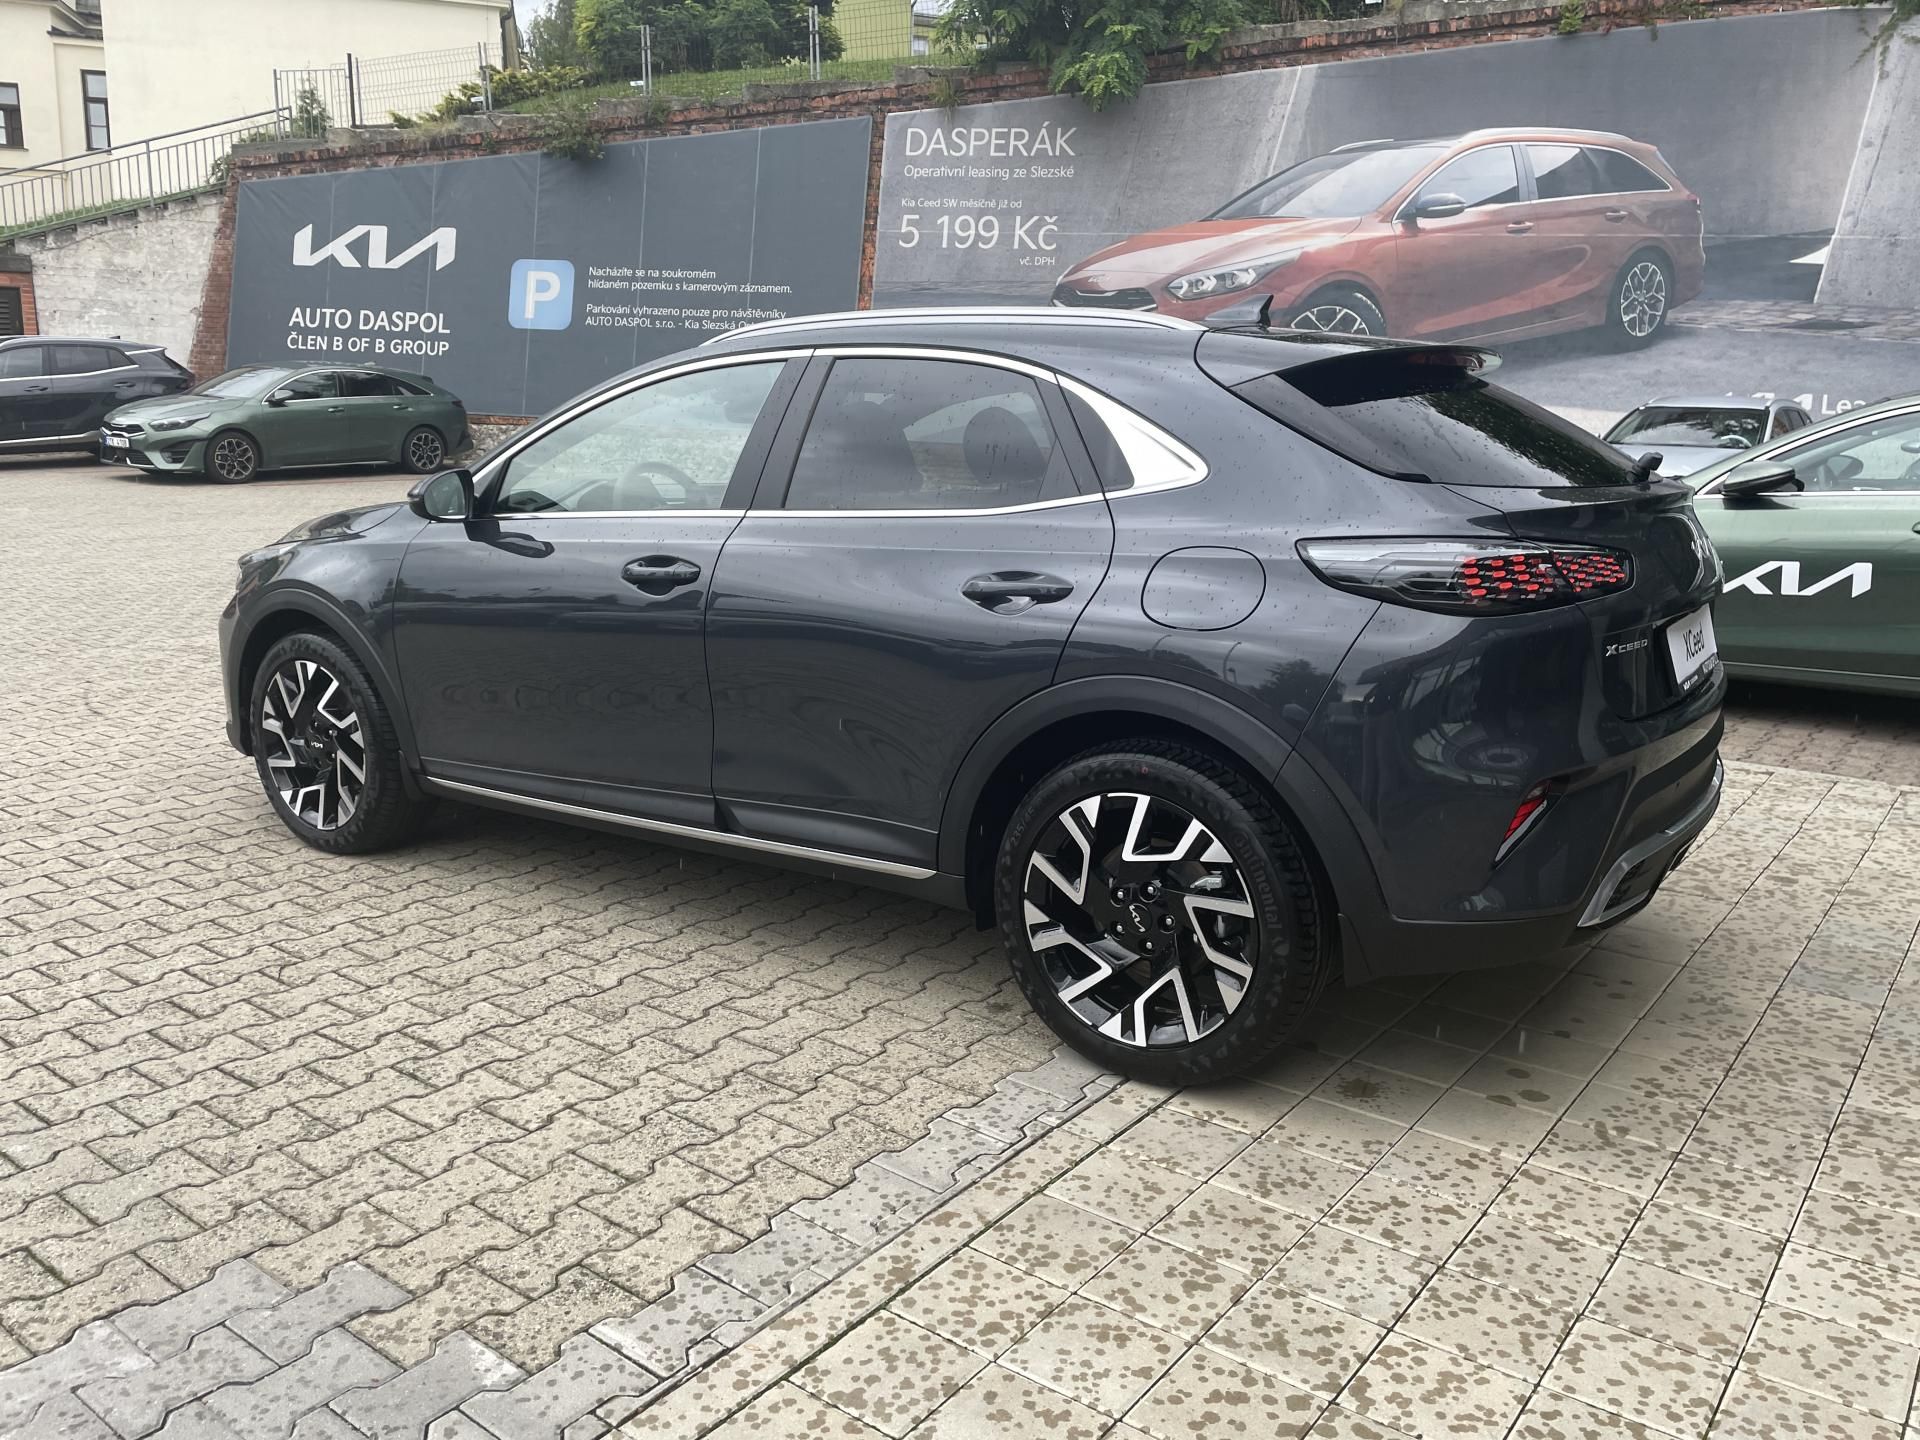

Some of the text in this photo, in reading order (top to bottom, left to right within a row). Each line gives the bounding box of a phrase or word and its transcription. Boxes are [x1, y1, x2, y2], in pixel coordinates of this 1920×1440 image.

[906, 121, 1077, 157] DASPERÁK
[904, 165, 1074, 181] Operativní leasing ze Slezské
[901, 198, 916, 208] Kia
[917, 199, 940, 208] Ceed
[943, 199, 958, 208] SW
[959, 199, 996, 209] měsíčně
[1010, 200, 1022, 208] od
[899, 214, 1058, 250] 5 199 Kč
[1019, 256, 1056, 266] vč. DPH
[588, 266, 716, 279] Nacházíte se na soukromém
[588, 279, 629, 289] hlídaném
[631, 281, 673, 291] pozemku
[682, 282, 737, 294] kamerovým
[739, 283, 793, 294] záznamem.
[524, 270, 561, 320] P
[586, 304, 787, 320] Parkování vyhrazeno pouze pro návštěvníky
[289, 307, 450, 334] AUTO DASPOL
[585, 316, 612, 326] AUTO
[614, 317, 653, 328] DASPOL
[655, 320, 676, 328] s.r.o.
[684, 320, 700, 329] Kia
[701, 320, 736, 330] Slezská
[287, 332, 449, 356] ČLEN B OF B GROUP
[1682, 620, 1705, 662] XCeed
